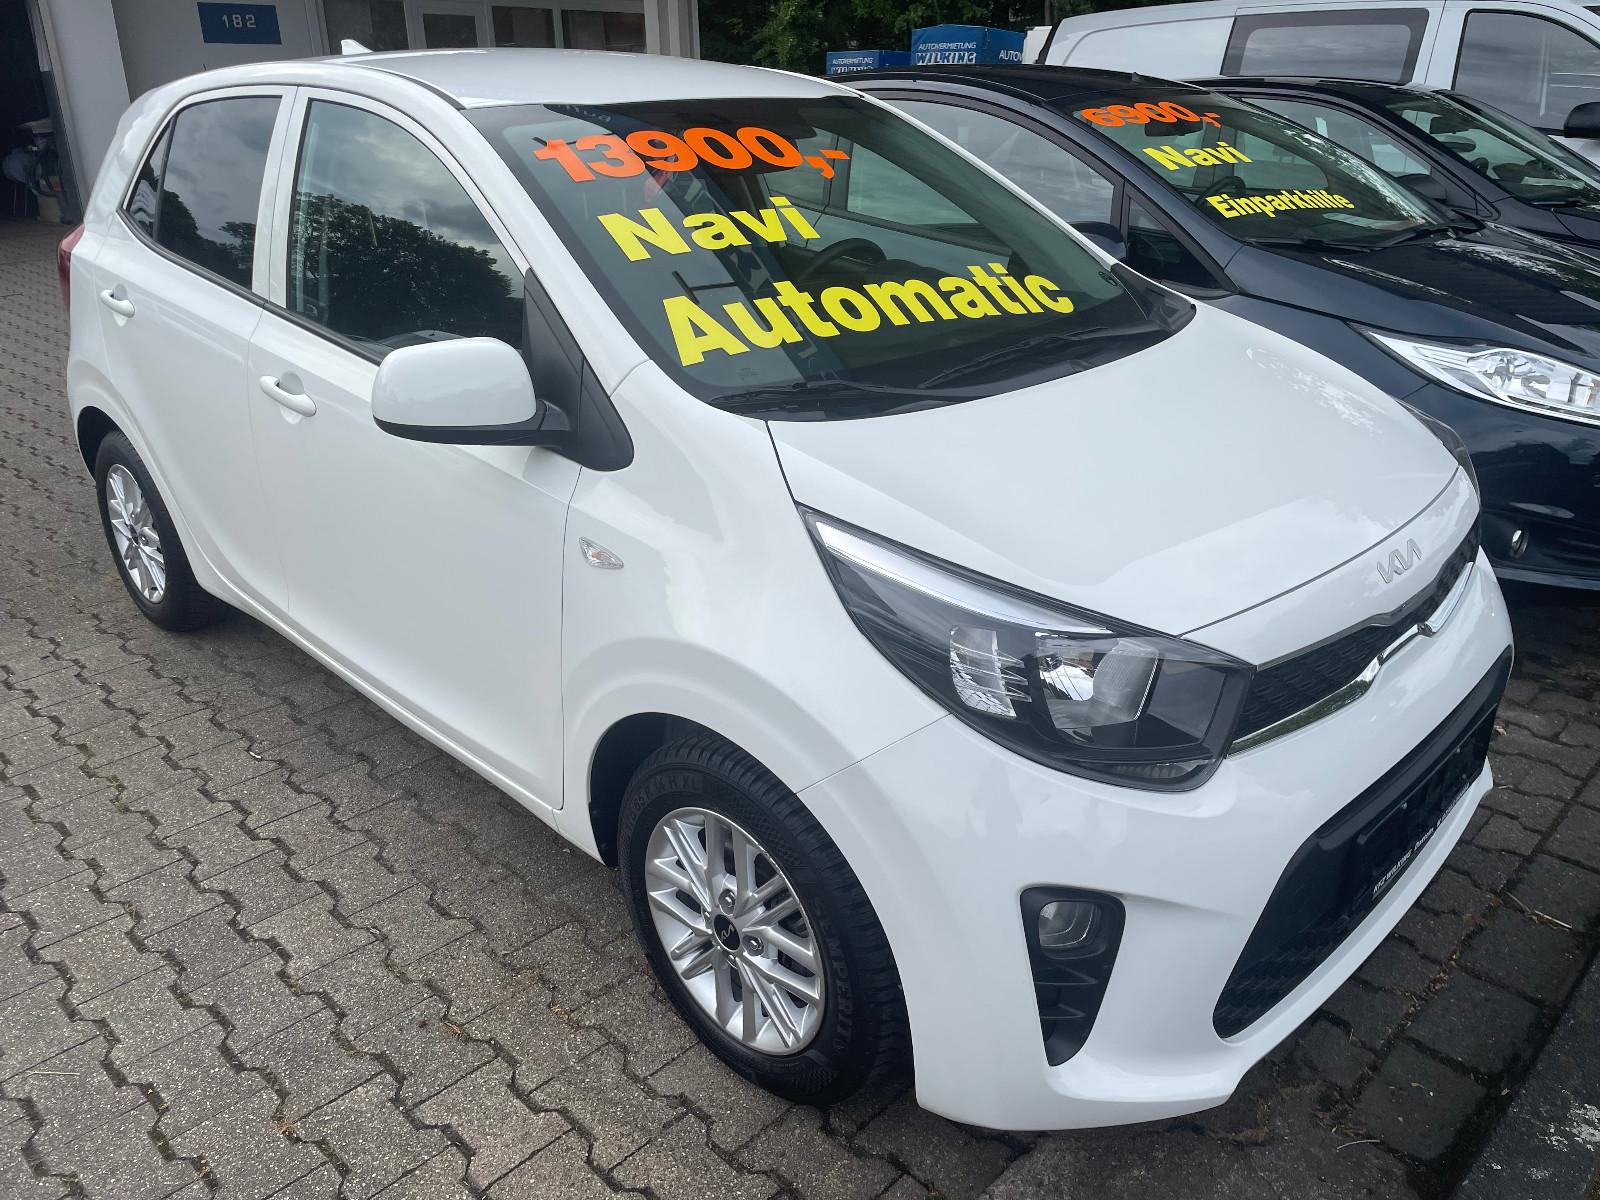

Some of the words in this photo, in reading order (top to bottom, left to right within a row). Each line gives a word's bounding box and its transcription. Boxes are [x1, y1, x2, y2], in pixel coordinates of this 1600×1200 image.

[222, 14, 256, 29] 182
[916, 52, 977, 65] WILKING
[918, 42, 977, 50] AUTOVERMIETUNG
[1080, 101, 1221, 128] 6900,-
[534, 126, 850, 183] 13900,-
[1142, 141, 1253, 171] Navi
[1205, 190, 1355, 218] Einparkhilfe
[597, 196, 820, 263] Navi
[662, 262, 1075, 367] Automatic
